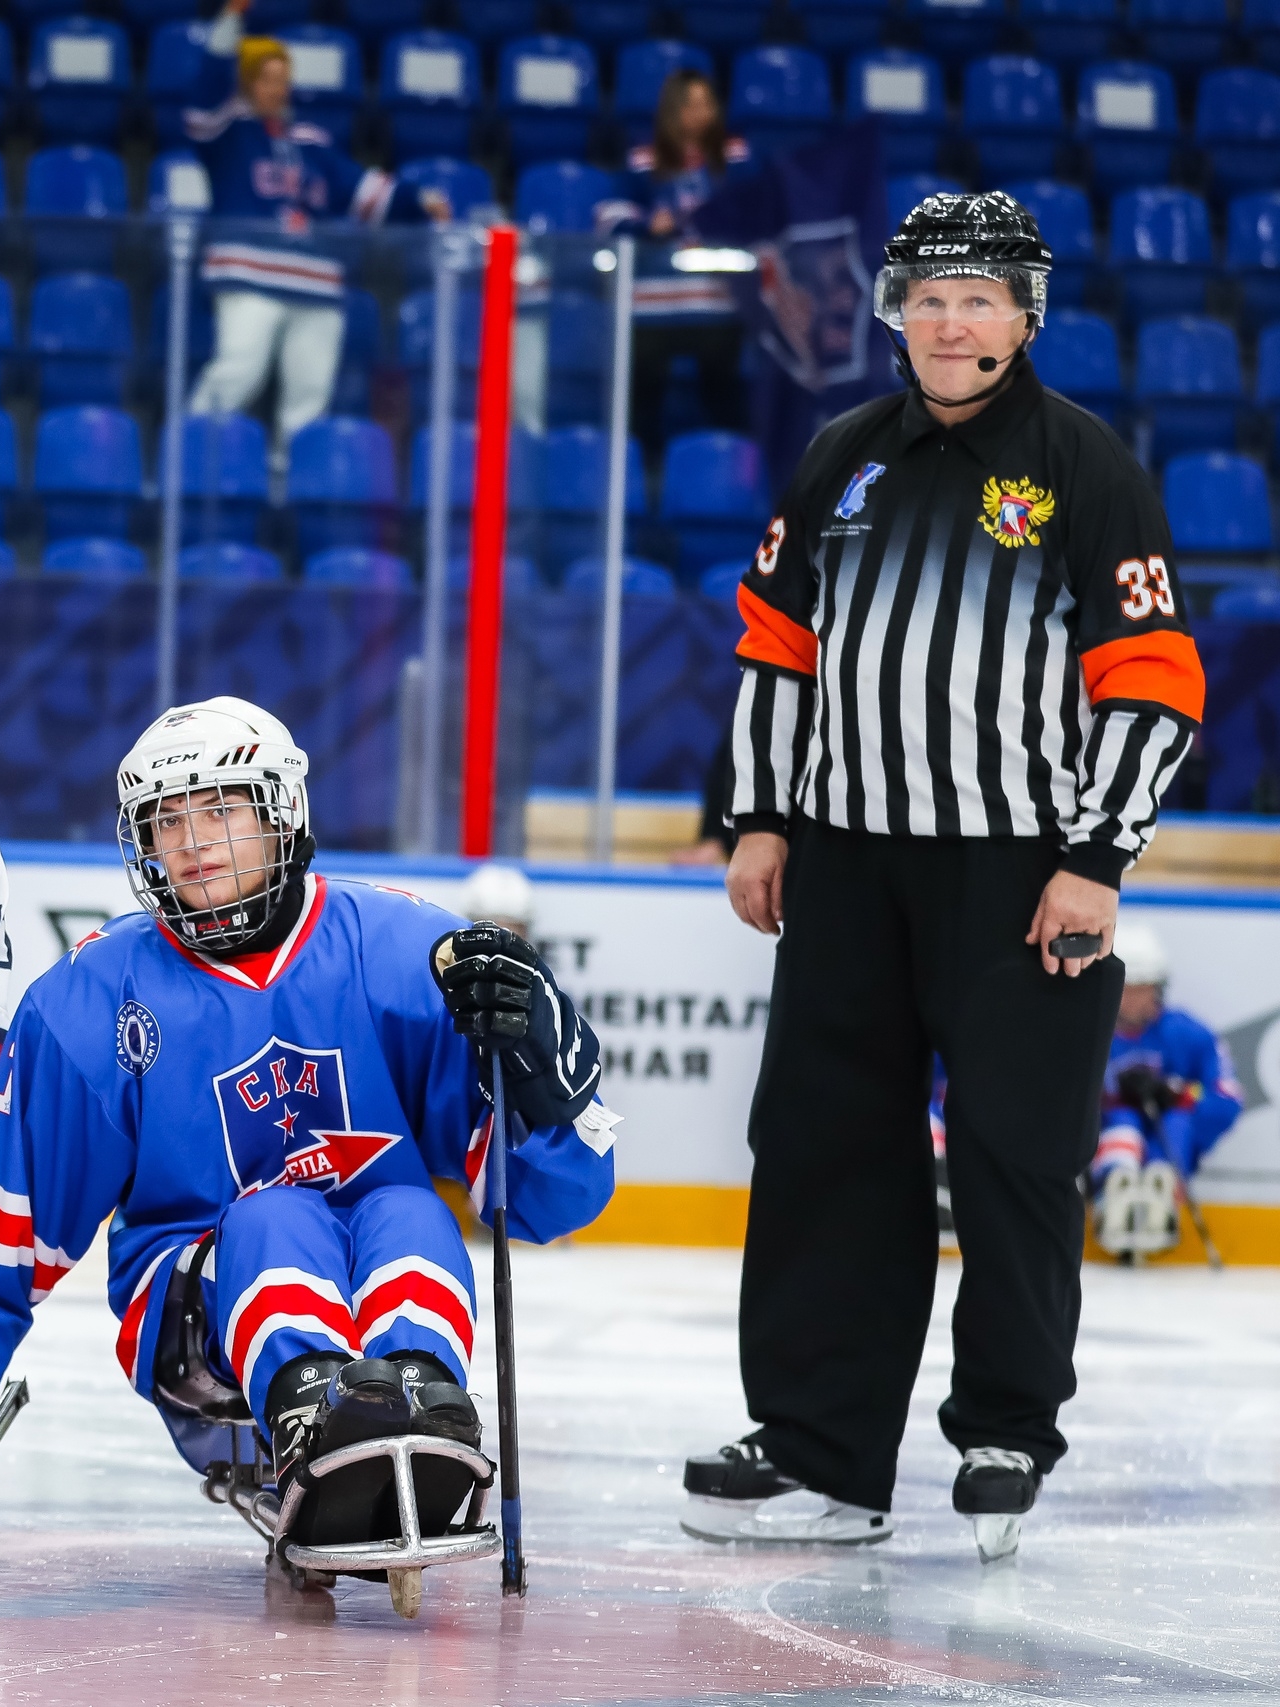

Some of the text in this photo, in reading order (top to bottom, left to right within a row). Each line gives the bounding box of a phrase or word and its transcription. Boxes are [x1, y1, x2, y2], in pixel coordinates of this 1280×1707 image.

[917, 244, 970, 256] CCM
[1115, 554, 1175, 622] 33
[151, 752, 199, 770] CCM
[284, 757, 302, 767] CCM
[236, 1057, 319, 1112] СКА
[296, 1377, 332, 1395] NORDWAY
